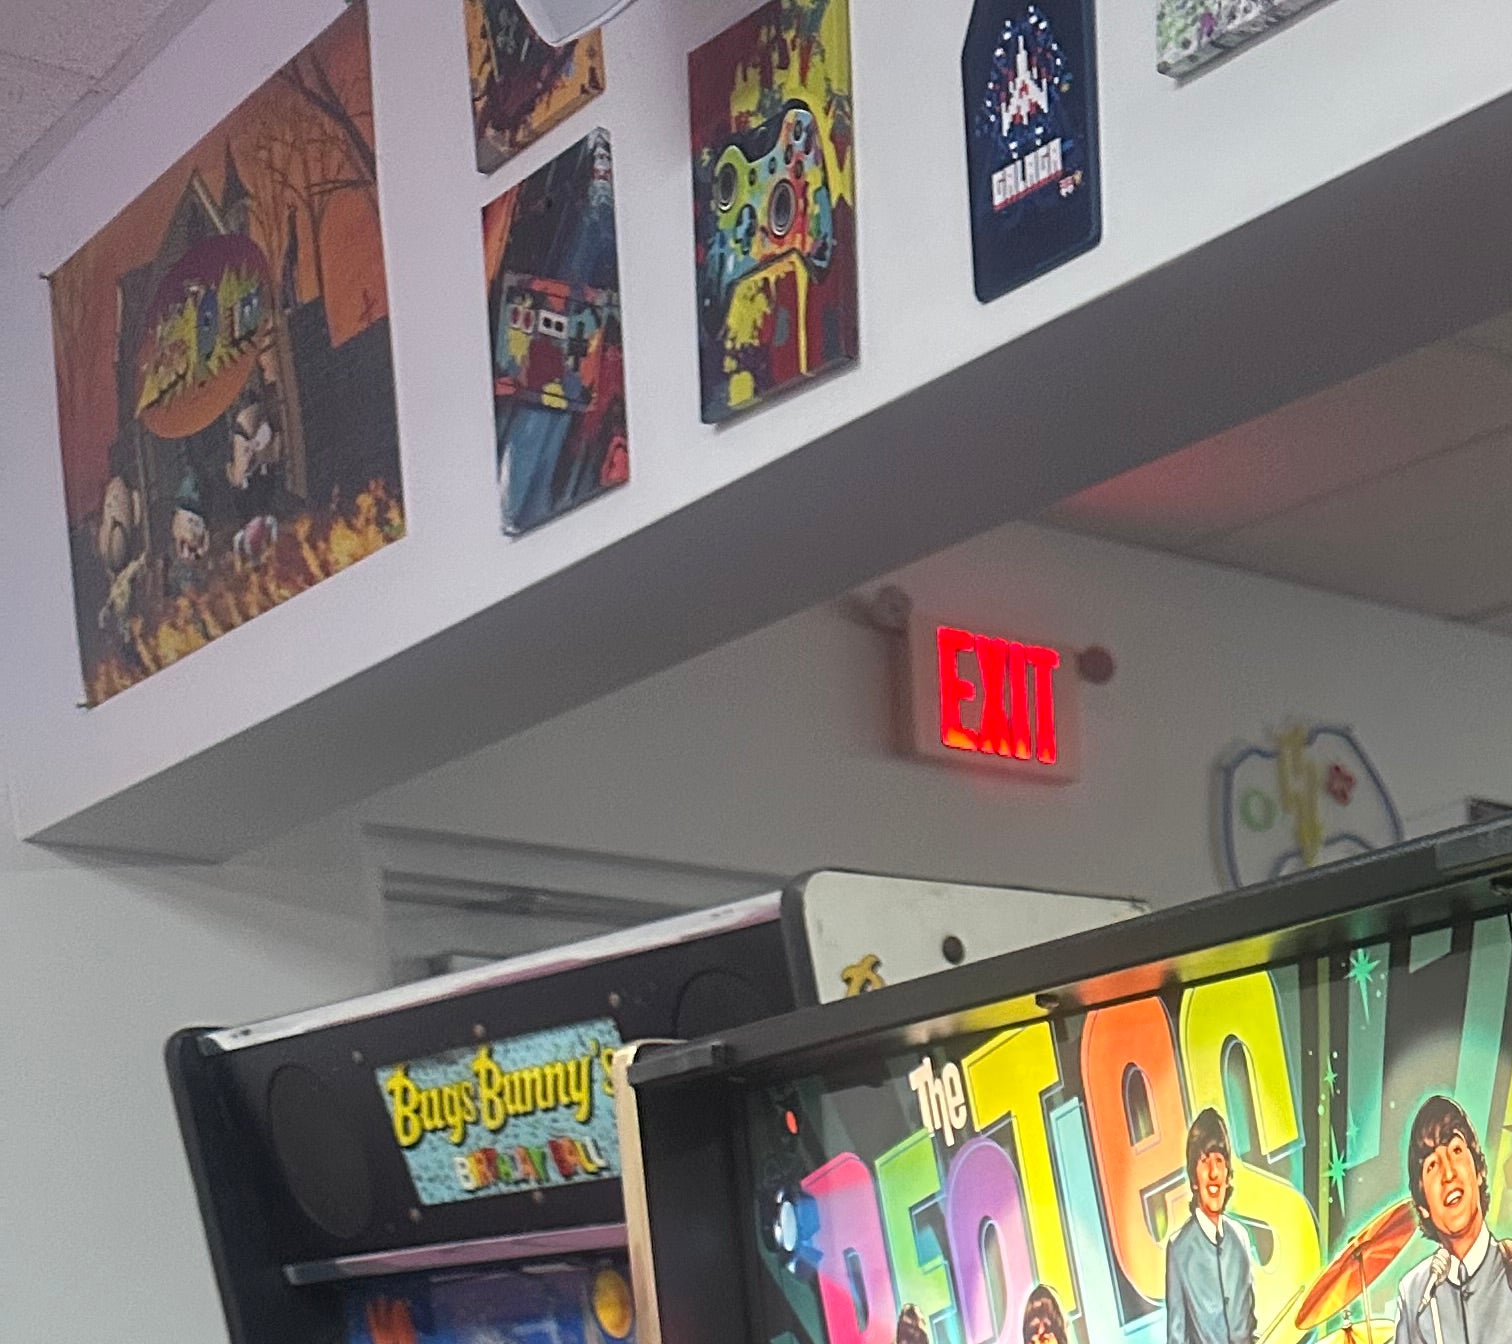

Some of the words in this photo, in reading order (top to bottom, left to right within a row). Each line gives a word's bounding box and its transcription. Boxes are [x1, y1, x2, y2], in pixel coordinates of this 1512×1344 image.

[992, 138, 1061, 206] GALAGA
[937, 626, 1059, 764] EXIT
[386, 1065, 477, 1146] Bugs
[909, 1055, 967, 1149] The
